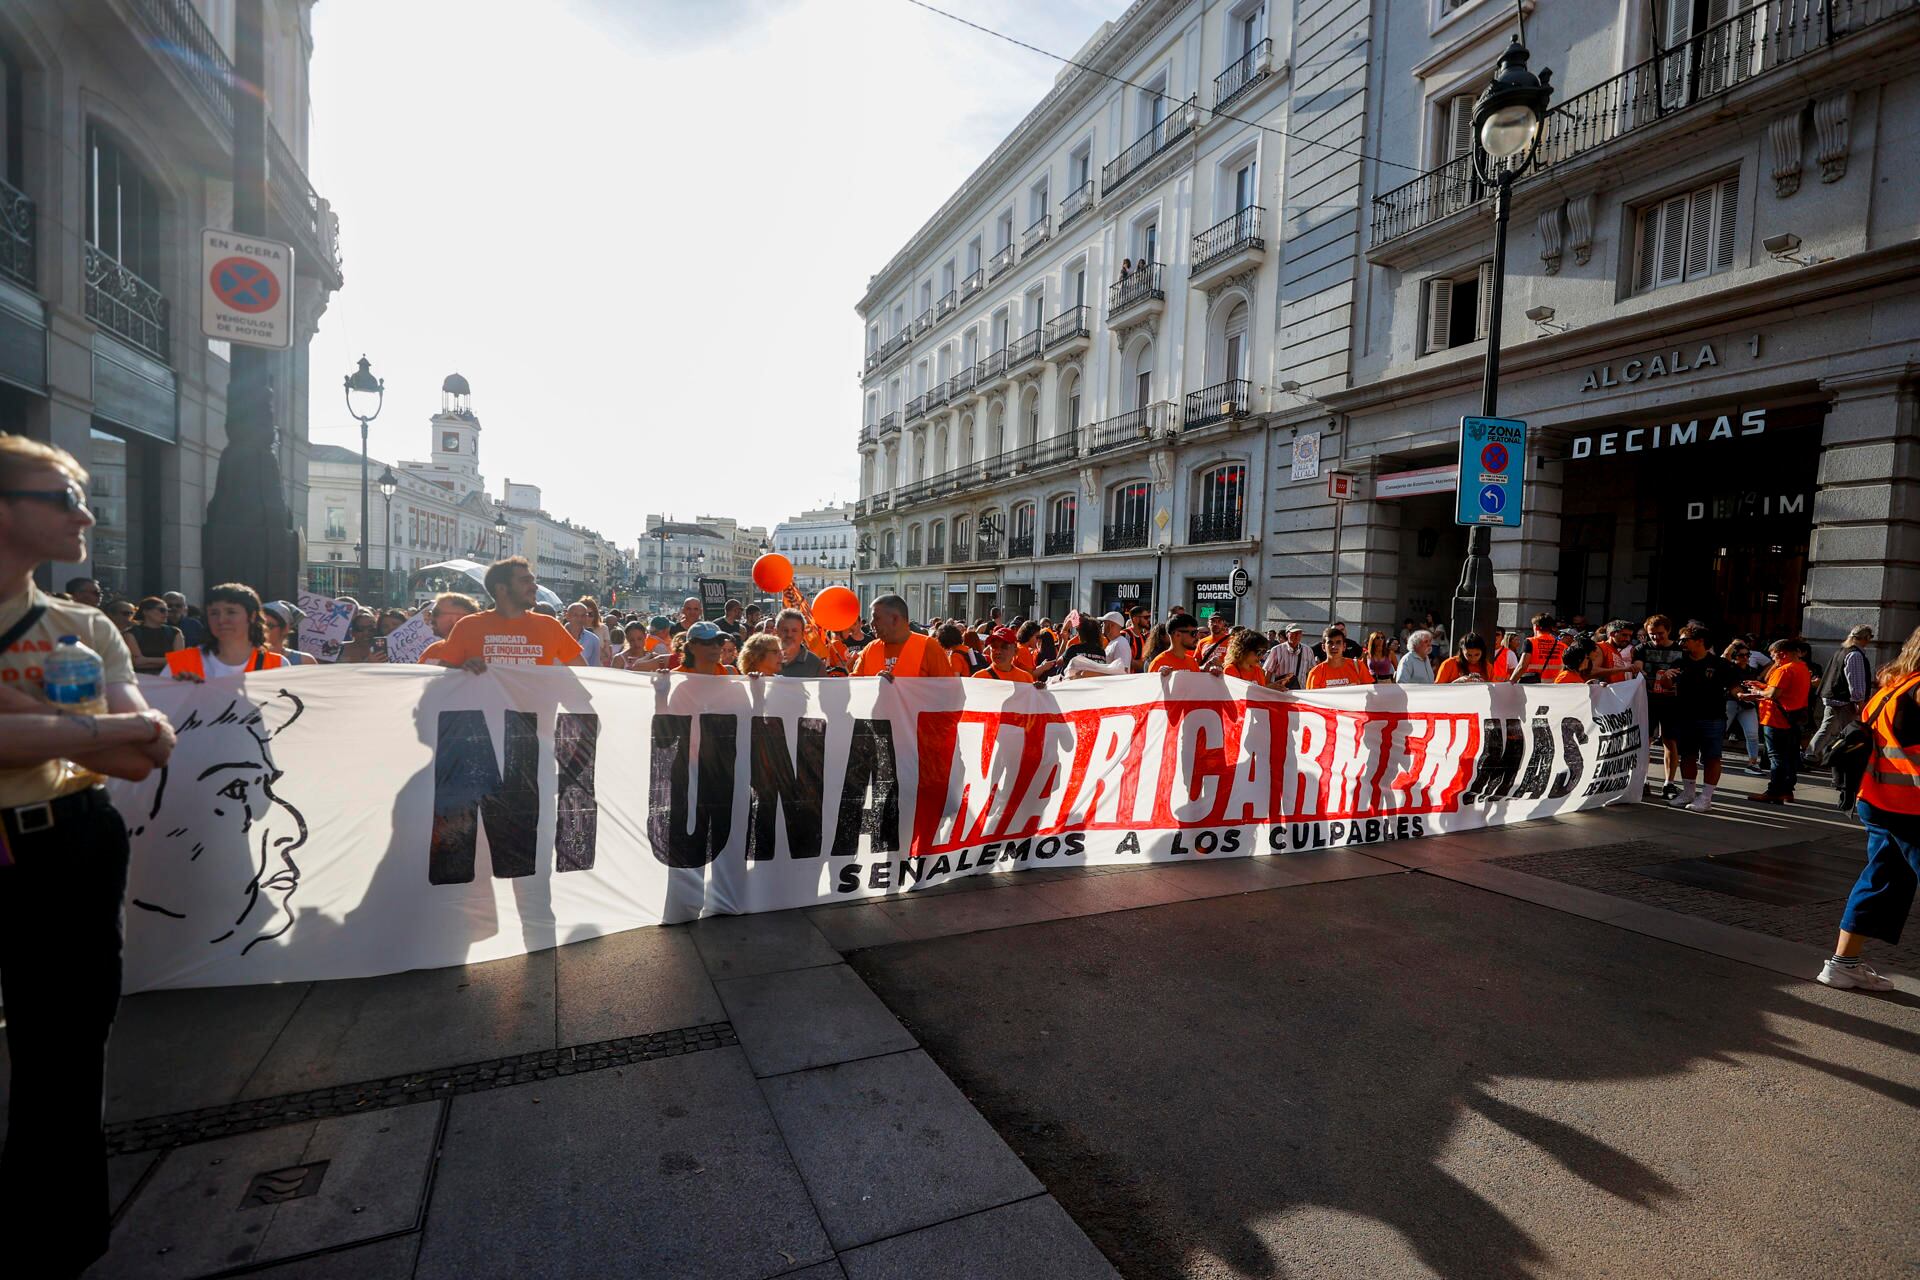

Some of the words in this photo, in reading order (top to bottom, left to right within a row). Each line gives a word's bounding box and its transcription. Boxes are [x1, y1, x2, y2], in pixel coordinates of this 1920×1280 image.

[209, 238, 229, 249] EN
[235, 243, 281, 260] ACERA
[217, 323, 232, 332] DE
[235, 326, 273, 338] MOTOR
[1579, 344, 1718, 392] ALCALA
[1747, 335, 1760, 357] 1
[1488, 425, 1521, 438] ZONA
[1572, 409, 1766, 459] DECIMAS
[1488, 436, 1521, 444] PEATONAL
[703, 582, 725, 597] TODO
[1118, 584, 1140, 599] GOIKO
[1197, 583, 1230, 592] GOURME
[1197, 592, 1233, 600] BURGERS
[484, 634, 528, 645] SINDICATO
[485, 646, 496, 655] DE
[496, 646, 542, 655] INQUILINAS
[428, 709, 598, 885] NI
[648, 713, 899, 868] UNA
[930, 704, 1473, 848] MARICARMEN
[1462, 705, 1588, 805] MÁS
[837, 832, 1086, 893] SEÑALEMOS
[1115, 831, 1141, 855] A
[1170, 829, 1242, 855] LOS
[1268, 816, 1424, 850] CULPABLES
